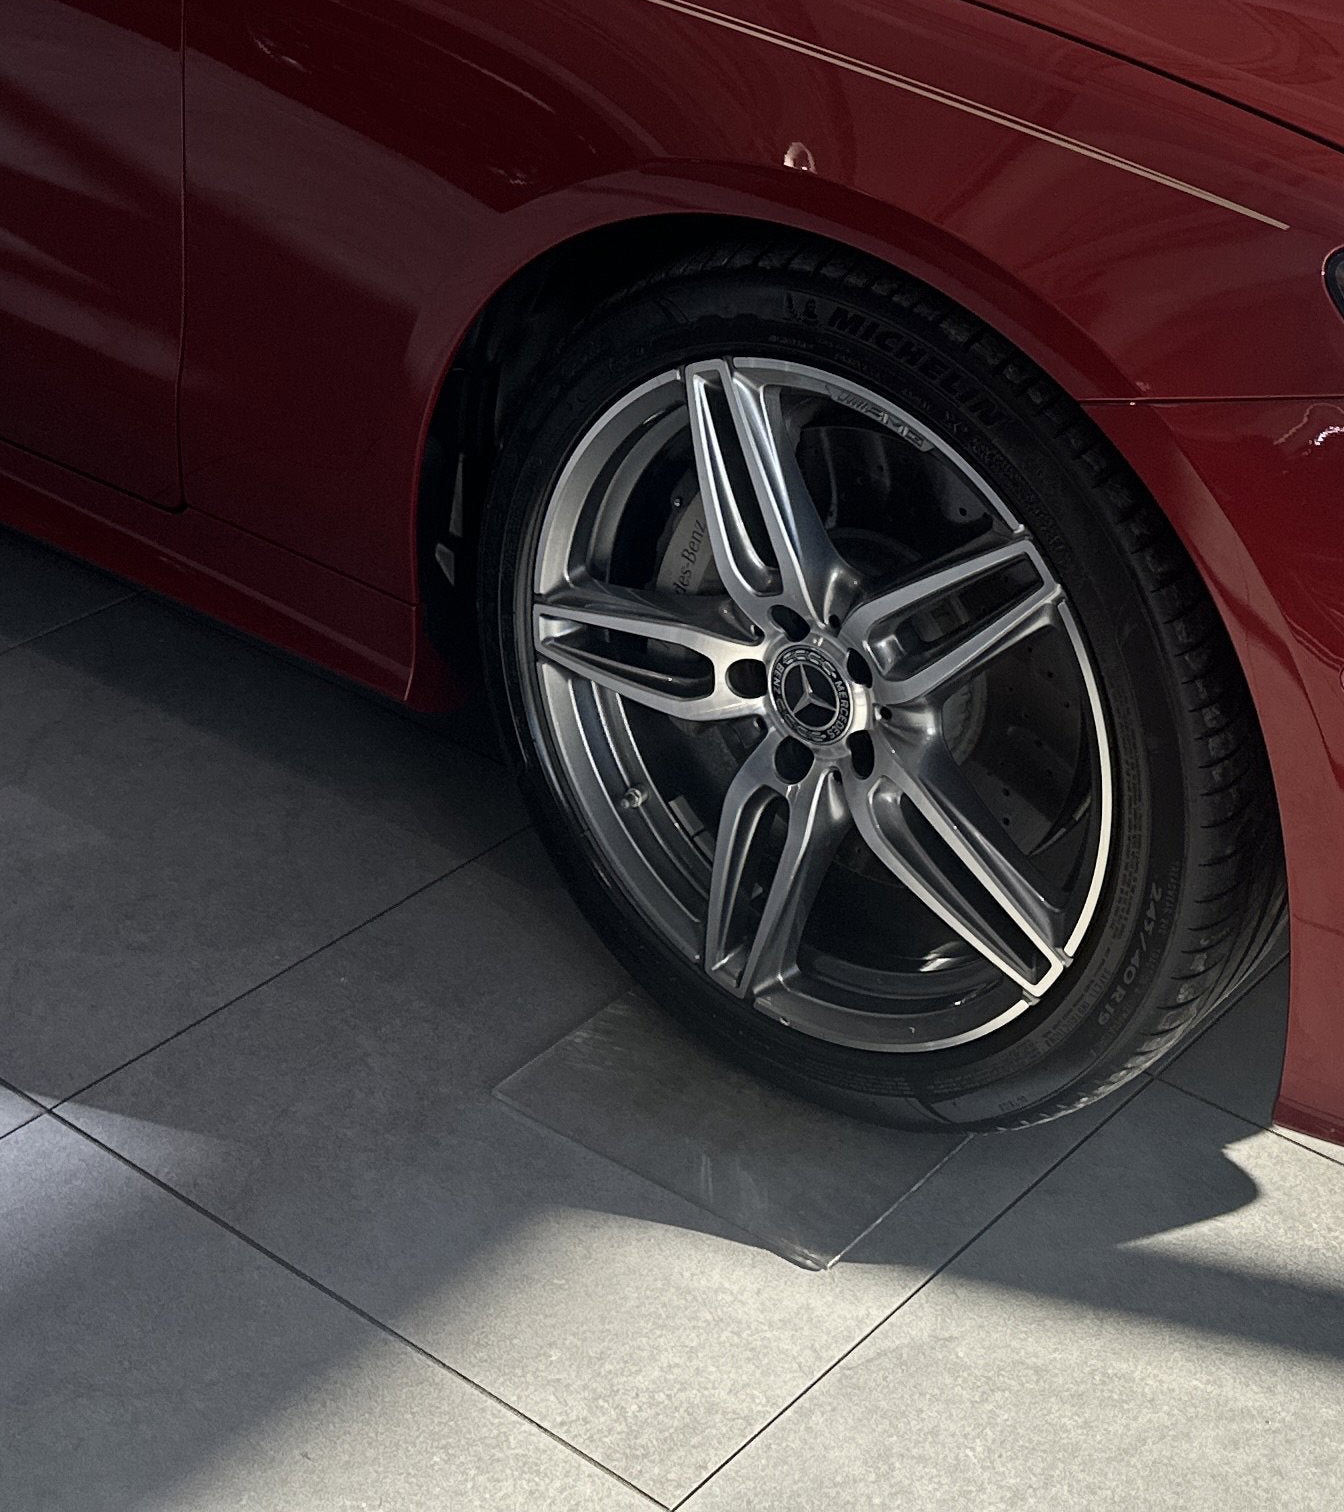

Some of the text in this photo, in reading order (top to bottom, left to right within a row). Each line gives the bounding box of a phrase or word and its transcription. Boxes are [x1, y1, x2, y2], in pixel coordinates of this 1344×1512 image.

[827, 306, 1010, 430] MICHELIN
[673, 519, 707, 595] des-Benz
[771, 662, 785, 696] BENZ
[826, 680, 850, 740] MERCEDES
